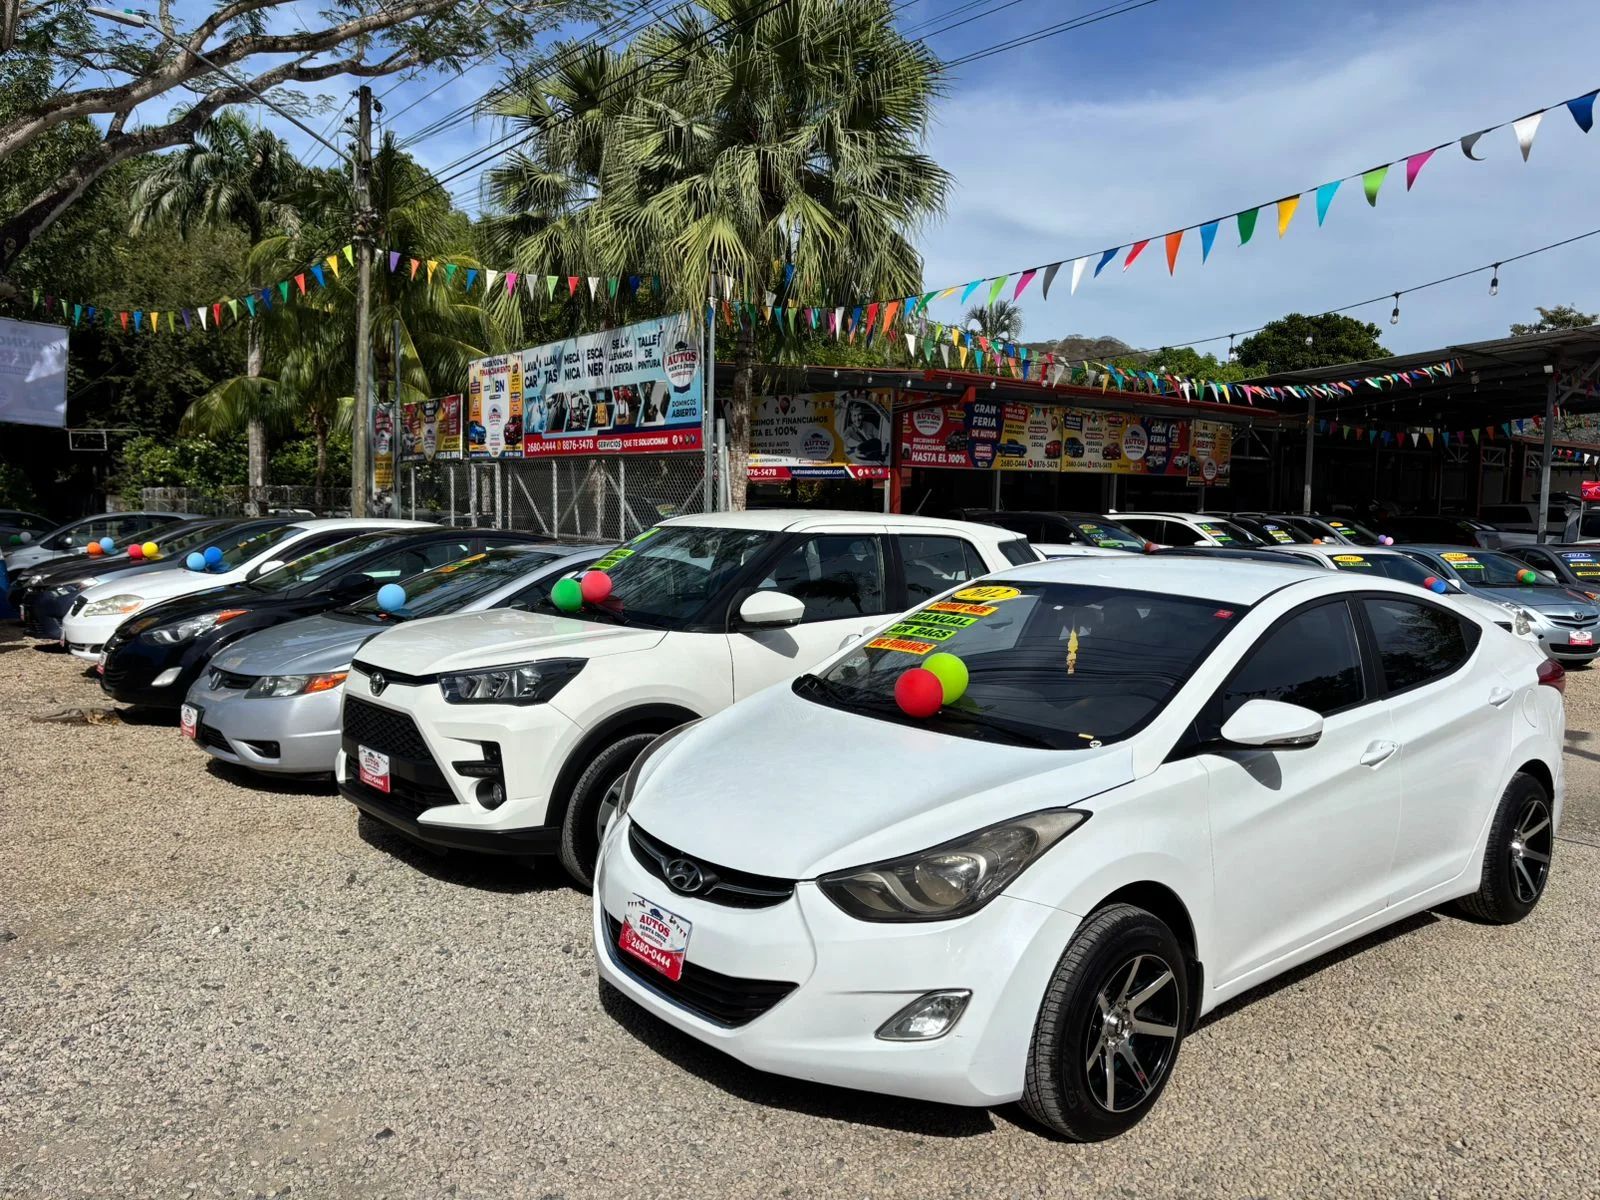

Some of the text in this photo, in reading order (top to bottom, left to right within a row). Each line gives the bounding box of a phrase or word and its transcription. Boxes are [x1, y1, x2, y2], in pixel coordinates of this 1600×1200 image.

[587, 347, 604, 360] ESCA
[609, 350, 633, 361] LLEVAMOS
[645, 348, 653, 358] DE
[667, 351, 697, 366] AUTOS
[544, 354, 557, 366] LLAN
[638, 358, 661, 370] PINTURA
[525, 362, 538, 373] LAVA
[587, 362, 604, 377] NER
[609, 362, 633, 374] A DEKRA
[545, 369, 558, 384] TAS
[564, 367, 581, 381] NICA
[495, 379, 505, 393] BN
[525, 375, 538, 389] CAR
[672, 399, 696, 407] DOMINGOS
[974, 403, 997, 415] GRAN
[672, 408, 697, 418] ABIERTO
[916, 413, 941, 421] AUTOS
[782, 415, 829, 425] FINANCIAMOS
[972, 416, 997, 428] FERIA
[774, 426, 797, 436] 100%
[971, 430, 997, 439] DE AUTOS
[527, 443, 556, 453] 2680-0444
[562, 440, 594, 450] 8876-5478
[599, 440, 622, 449] SERVICIOS
[623, 440, 632, 448] QUE
[638, 437, 669, 447] SOLUCIONAN
[1125, 438, 1146, 446] AUTOS
[1150, 435, 1167, 443] FERIA
[912, 443, 947, 452] FINANCIAMOS
[912, 452, 937, 463] HASTA
[938, 453, 948, 463] EL
[948, 454, 967, 464] 100%
[1000, 459, 1027, 468] 2680-0444
[747, 468, 777, 476] 876-5478
[910, 612, 970, 626] MANUAL
[889, 624, 951, 638] AIR BAGS
[639, 913, 671, 938] AUTOS
[640, 924, 667, 943] SANTA CRUZ
[630, 937, 671, 969] 2680-0444
